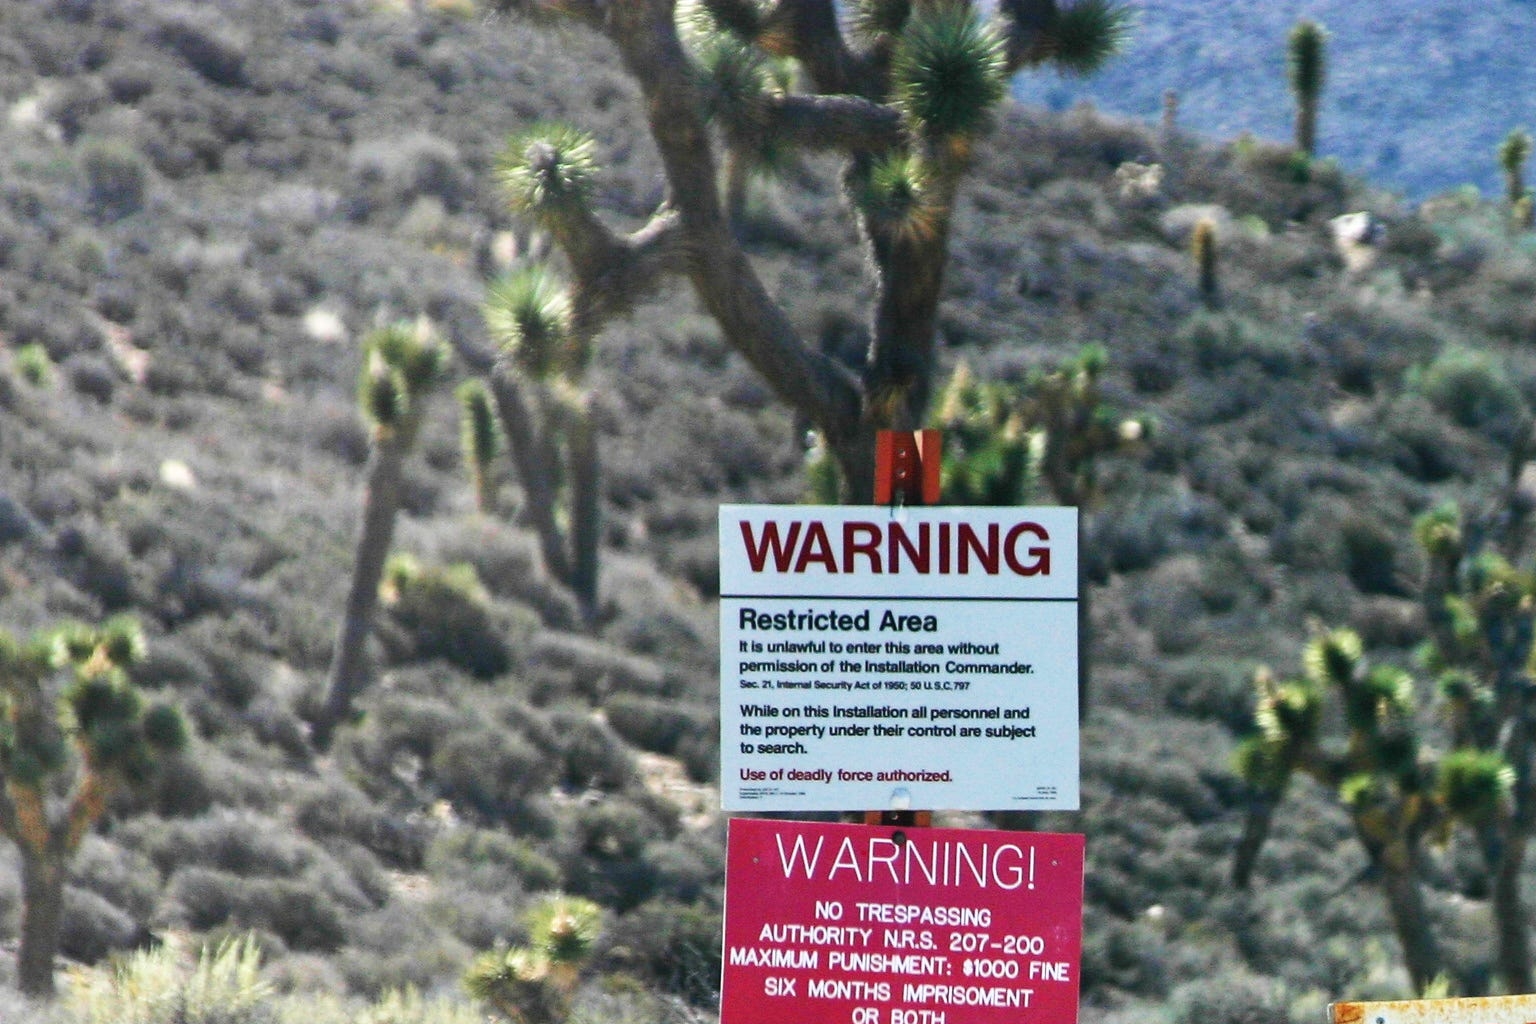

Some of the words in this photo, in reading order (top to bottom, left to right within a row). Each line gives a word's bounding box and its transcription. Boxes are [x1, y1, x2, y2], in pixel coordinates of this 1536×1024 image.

[739, 520, 1051, 576] WARNING
[739, 608, 870, 632] Restricted
[879, 610, 938, 632] Area
[739, 640, 748, 653] It
[751, 640, 764, 653] is
[767, 640, 826, 654] unlawful
[829, 642, 843, 654] to
[846, 642, 882, 654] enter
[885, 641, 911, 654] this
[914, 643, 944, 655] area
[947, 642, 1000, 655] without
[739, 660, 821, 675] permission
[821, 660, 835, 673] of
[840, 660, 862, 673] the
[865, 660, 940, 673] Installation
[945, 661, 1034, 674] Commander.
[740, 680, 760, 689] Sec.
[777, 680, 812, 689] Internal
[814, 680, 852, 691] Security
[854, 681, 871, 690] Act
[872, 681, 882, 690] of
[910, 681, 921, 690] 50
[953, 681, 970, 690] 797
[740, 705, 779, 717] While
[782, 708, 800, 717] on
[804, 705, 829, 718] this
[833, 705, 908, 718] Installation
[912, 706, 927, 718] all
[930, 707, 1000, 721] personnel
[1003, 707, 1030, 719] and
[740, 724, 761, 736] the
[765, 724, 825, 739] property
[829, 724, 870, 736] under
[873, 724, 904, 736] their
[907, 725, 956, 737] control
[960, 727, 981, 737] are
[985, 725, 1036, 740] subject
[740, 742, 754, 754] to
[757, 742, 808, 754] search.
[740, 768, 765, 780] Use
[769, 769, 784, 781] of
[787, 769, 832, 784] deadly
[838, 769, 873, 781] force
[876, 769, 952, 782] authorized.
[776, 833, 1035, 890] WARNING!
[815, 901, 843, 920] NO
[856, 903, 992, 927] TRESPASSING
[759, 923, 873, 946] AUTHORITY
[883, 930, 938, 950] N.R.S.
[950, 933, 1044, 955] 207-200
[729, 947, 818, 969] MAXIMUM
[828, 951, 952, 975] PUNISHMENT:
[962, 958, 1019, 979] $1000
[1029, 961, 1070, 982] FINE
[764, 977, 796, 997] SIX
[808, 979, 891, 1001] MONTHS
[903, 983, 1034, 1008] IMPRISOMENT
